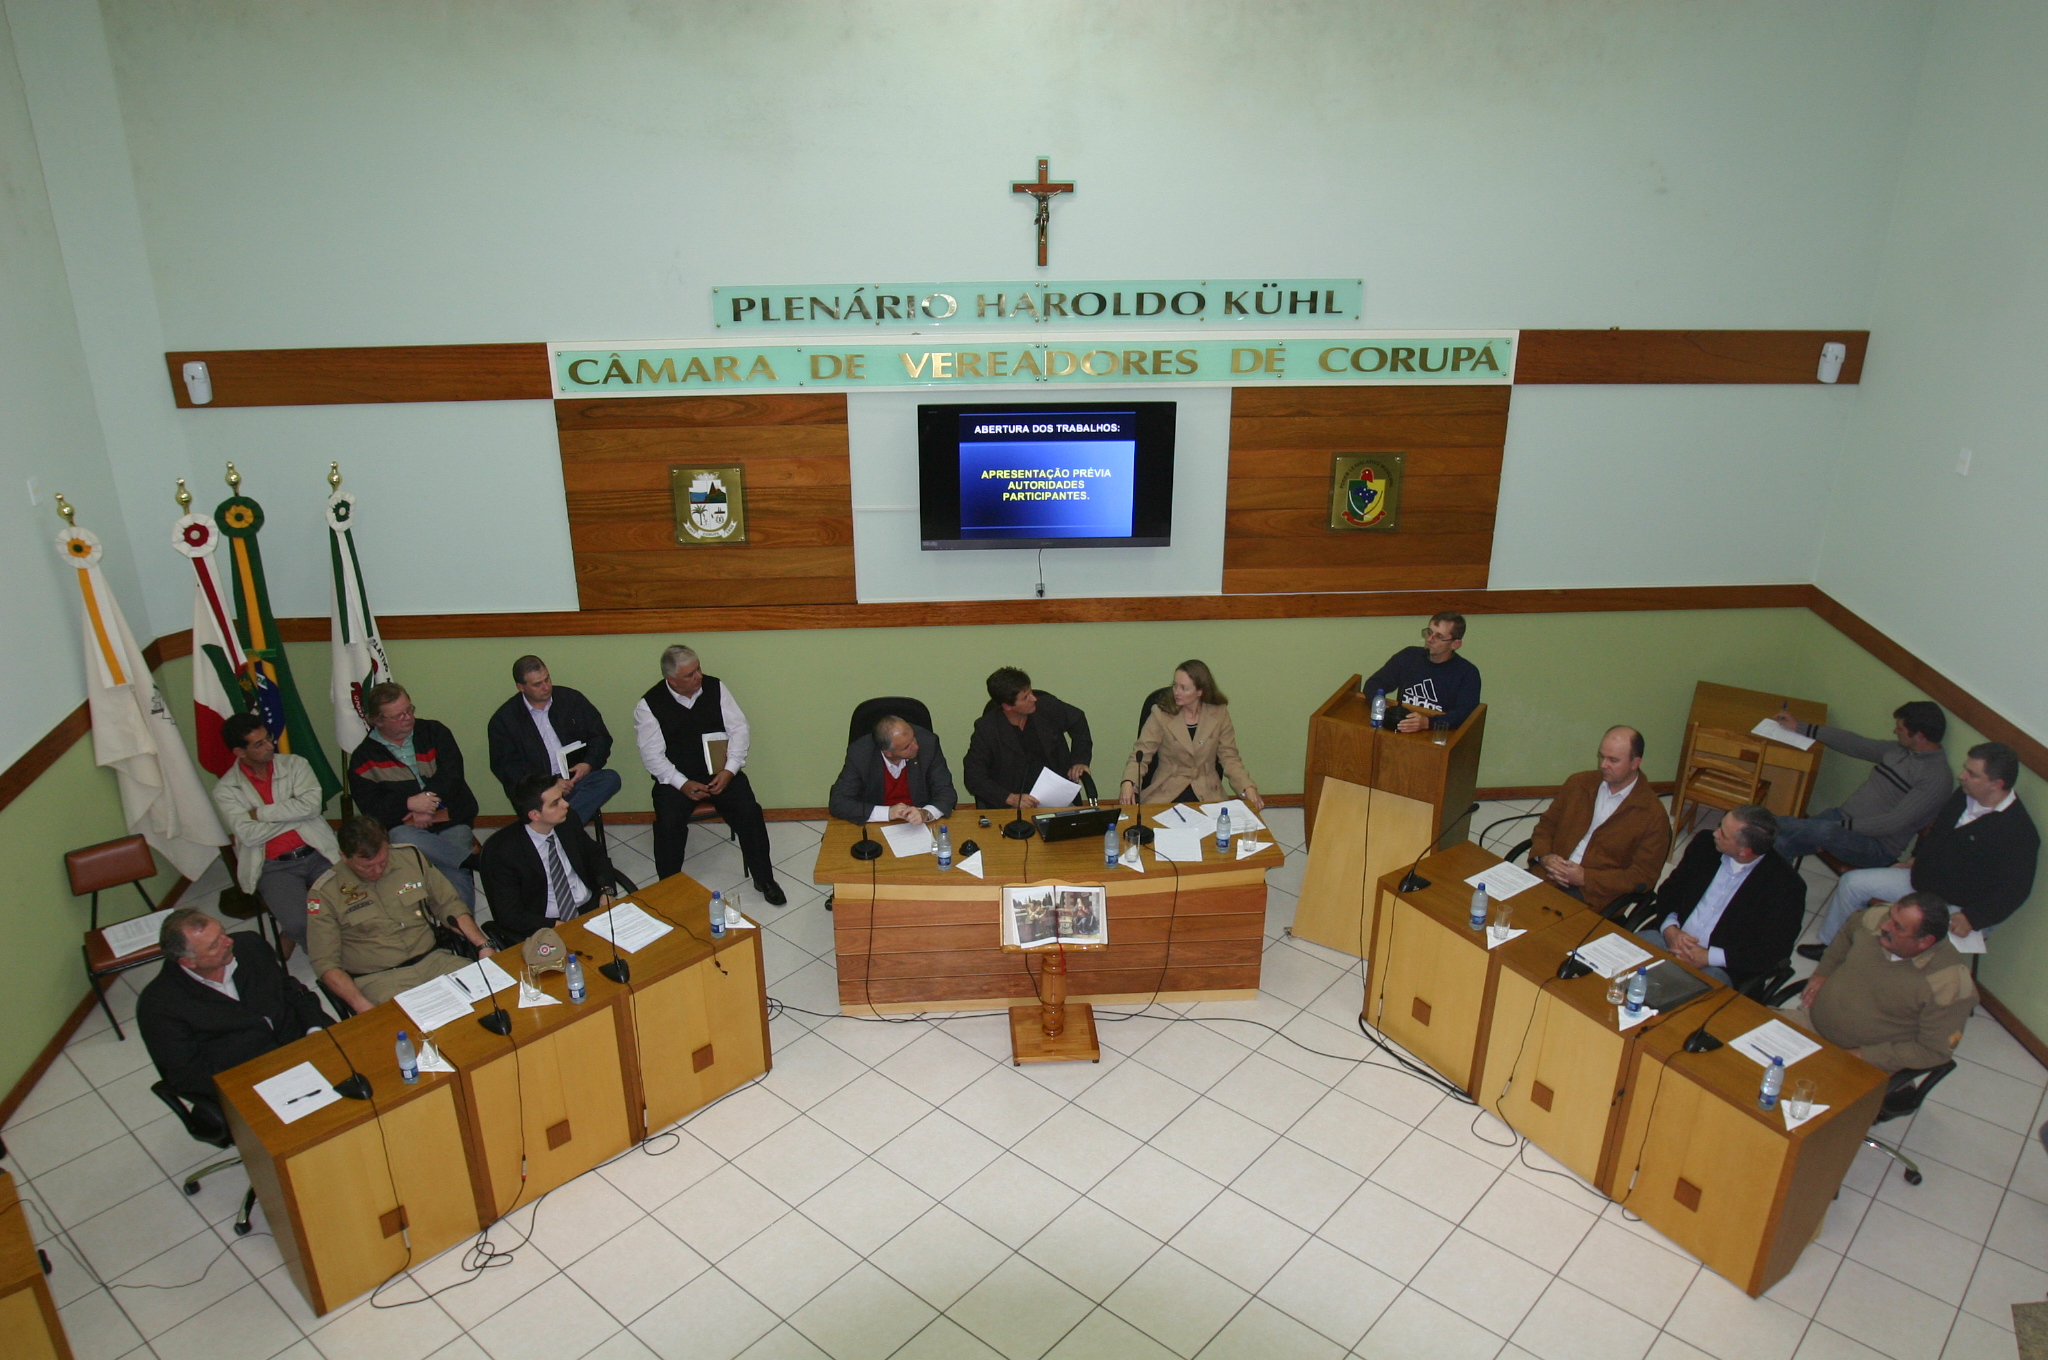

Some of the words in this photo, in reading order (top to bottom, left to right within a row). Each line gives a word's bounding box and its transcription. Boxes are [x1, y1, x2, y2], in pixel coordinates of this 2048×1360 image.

[731, 287, 957, 322] PLENÁRIO
[976, 290, 1206, 319] HAROLDO
[1223, 283, 1343, 316] KÜHL
[568, 353, 779, 385] CÂMARA
[809, 353, 867, 380] DE
[899, 348, 1199, 379] VEREADORES
[1230, 346, 1286, 374] DE
[1318, 341, 1500, 373] CORUPÁ
[974, 424, 1029, 434] ABERTURA
[1032, 424, 1054, 433] DOS
[1056, 423, 1121, 433] TRABALHOS:
[981, 468, 1070, 480] APRESENTAÇÃO
[1073, 467, 1112, 478] PRÉVIA
[1007, 480, 1085, 490] AUTORIDADES
[1002, 491, 1090, 502] PARTICIPANTES.
[1402, 694, 1443, 712] adidas
